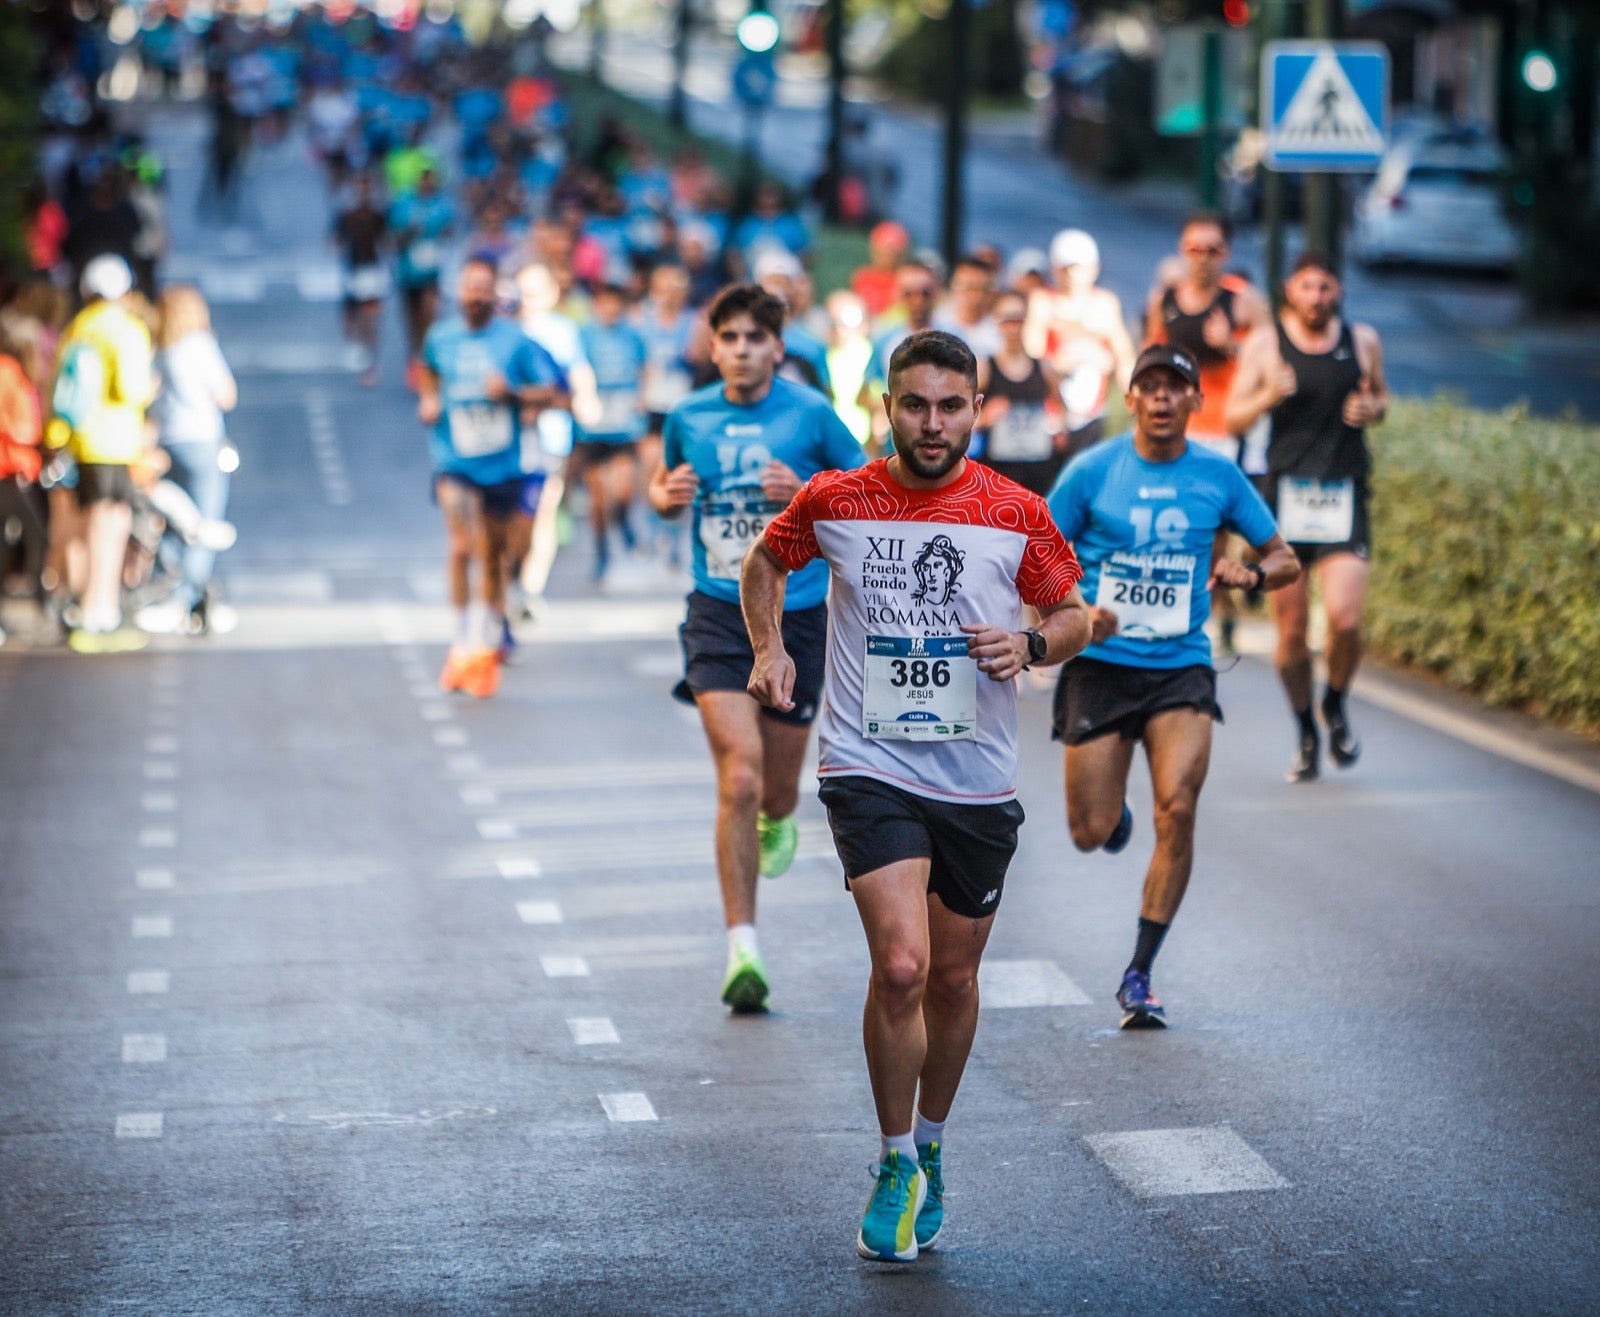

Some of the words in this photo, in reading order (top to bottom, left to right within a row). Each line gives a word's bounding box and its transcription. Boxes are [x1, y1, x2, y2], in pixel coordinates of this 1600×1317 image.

[864, 536, 906, 562] XII
[862, 562, 907, 576] Prueba
[862, 575, 907, 590] Fondo
[864, 594, 898, 606] VILLA
[1113, 582, 1175, 607] 2606
[866, 607, 961, 626] ROMANA
[890, 659, 951, 688] 386
[906, 688, 934, 699] JESÚS
